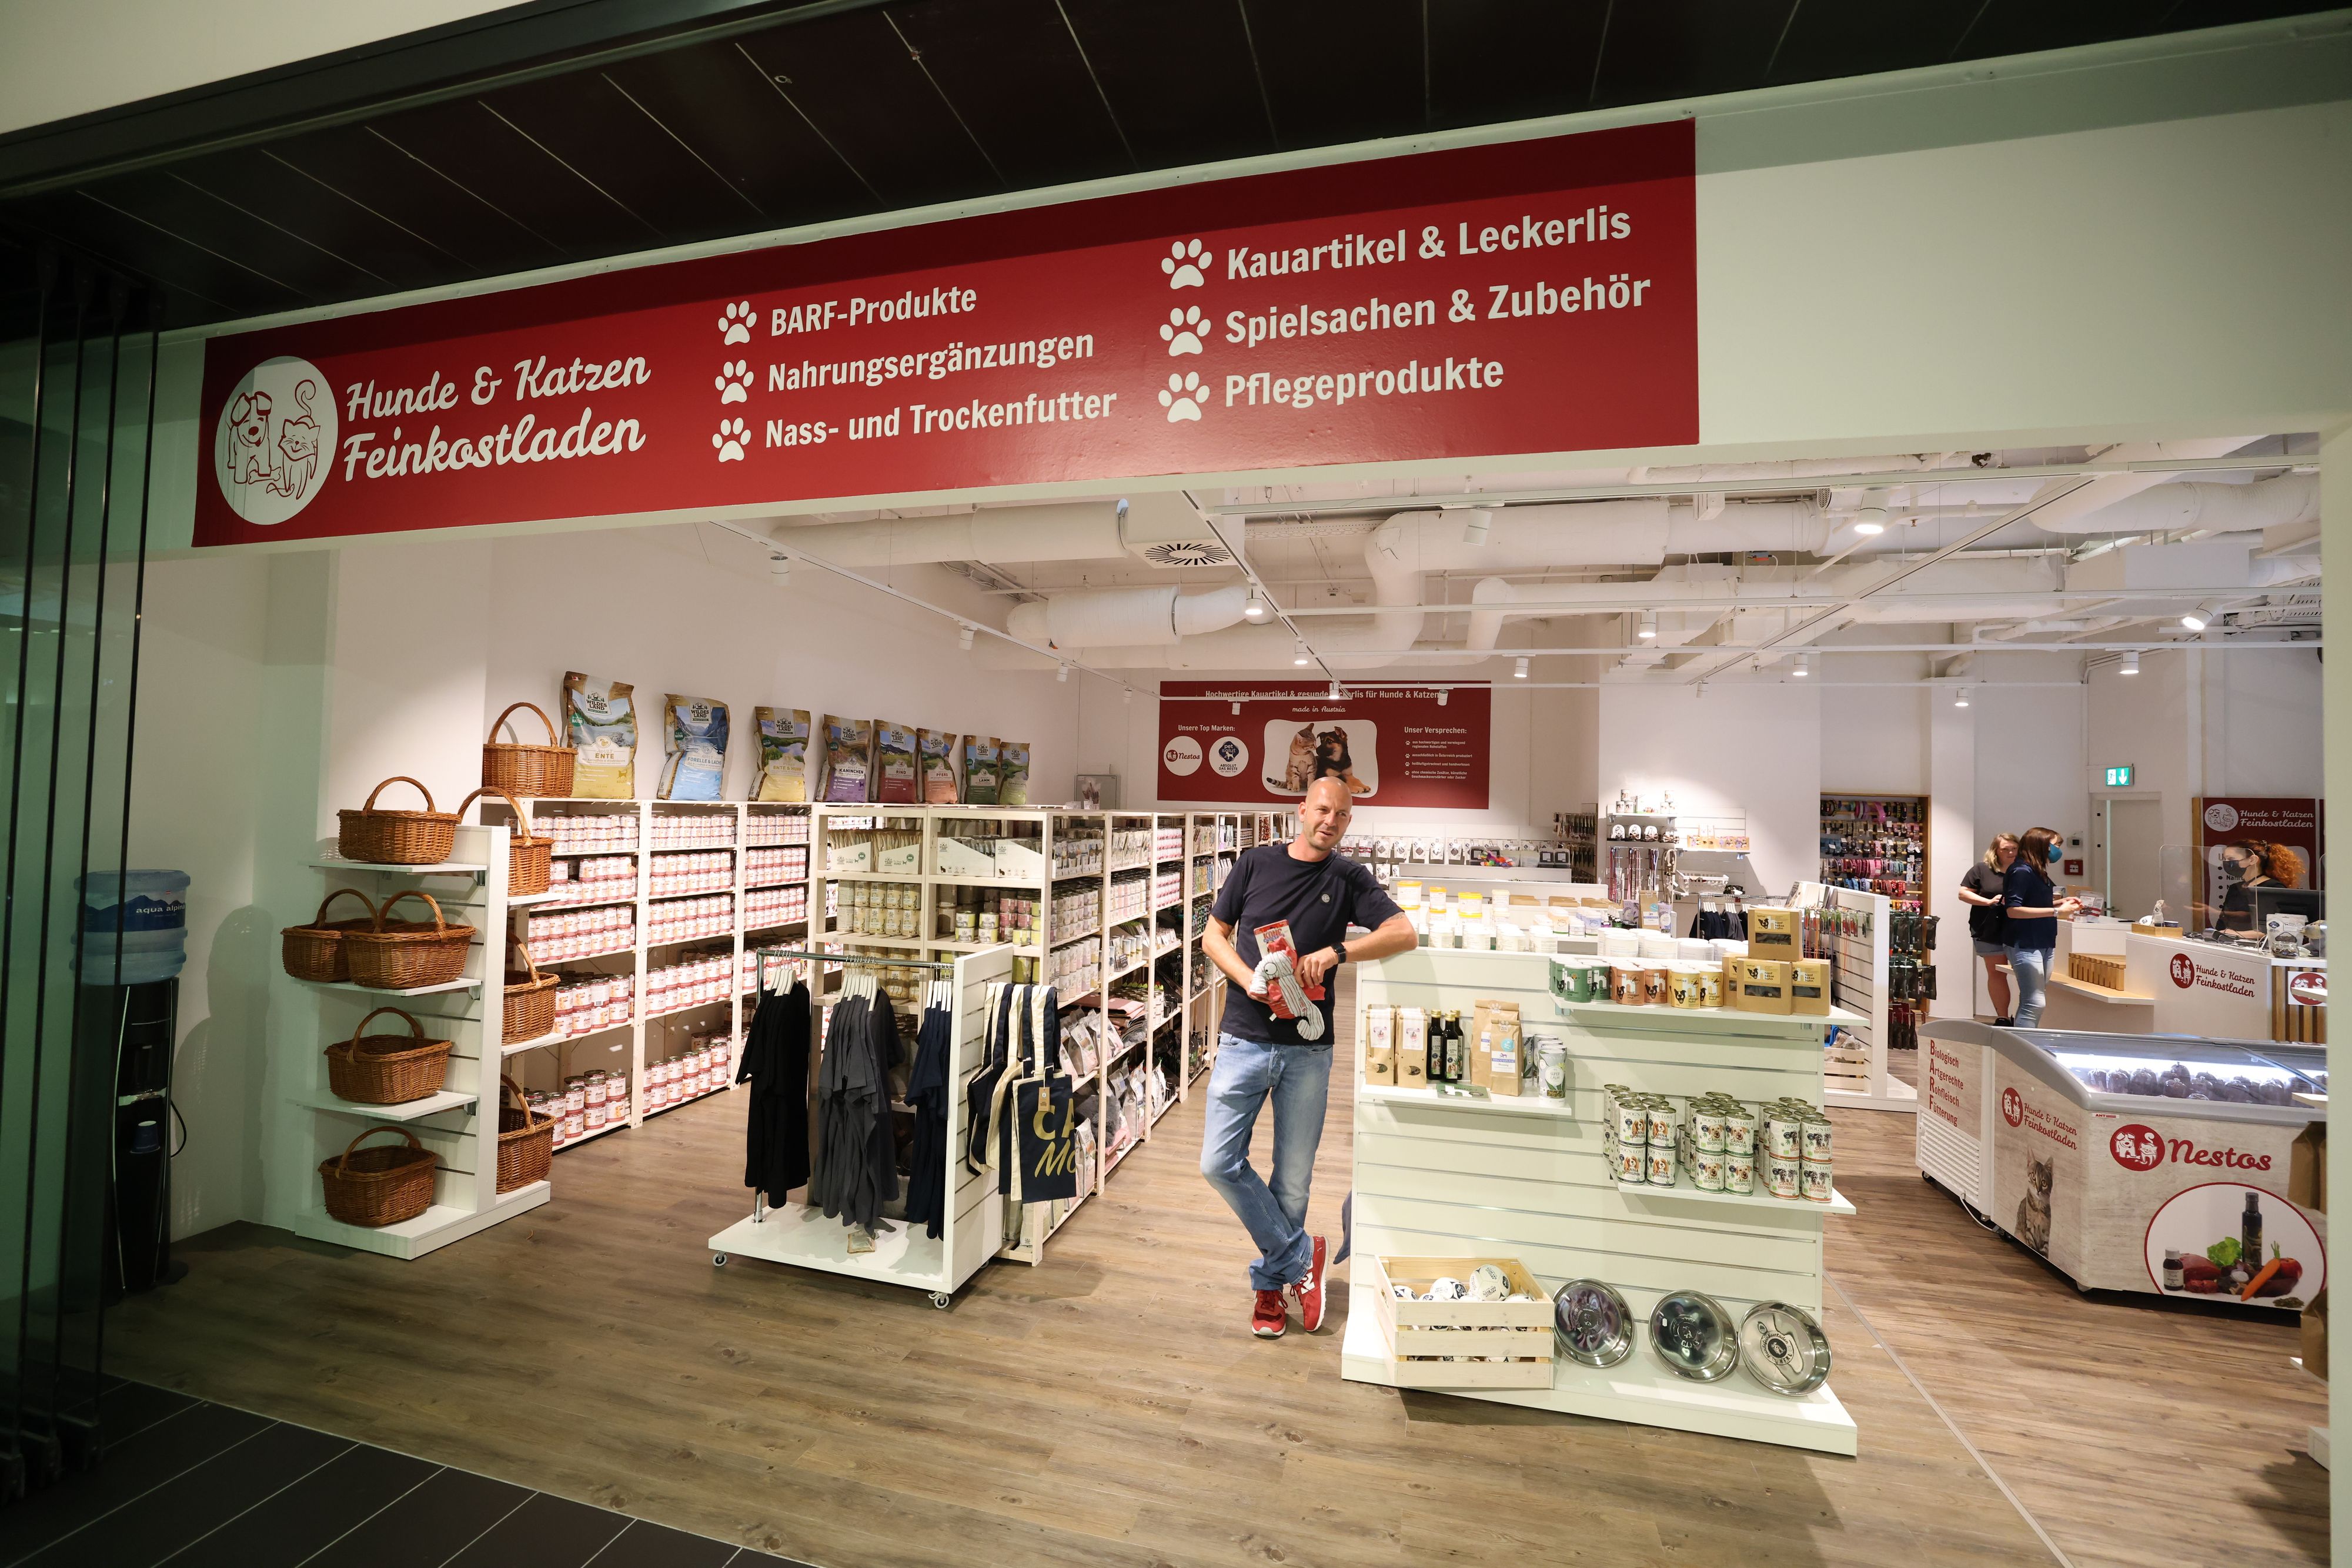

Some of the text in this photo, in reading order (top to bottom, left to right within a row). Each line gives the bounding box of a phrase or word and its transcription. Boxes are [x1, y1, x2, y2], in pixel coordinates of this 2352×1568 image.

[1228, 205, 1631, 280] Kauartikel & Leckerlis
[771, 286, 977, 336] BARF-Produkte
[1225, 273, 1651, 347] Spielsachen & Zubehör
[768, 333, 1094, 392] Nahrungsergänzungen
[347, 355, 651, 421] Hunde & Katzen
[1225, 357, 1504, 408] Pflegeprodukte
[766, 391, 1117, 449] Nass- und Trockenfutter
[343, 406, 647, 482] Feinkostladen
[586, 699, 607, 707] WILDES
[1414, 690, 1438, 698] Katzen
[2240, 818, 2314, 828] Feinkostladen
[1263, 928, 1282, 940] KONG
[2196, 964, 2255, 984] Hunde & Katzen
[2196, 975, 2255, 998] Feinkostladen
[1930, 1039, 1959, 1068] Biologisch
[1929, 1058, 1964, 1090] Artgerechte
[1929, 1076, 1959, 1107] Rohfleisch
[1929, 1094, 1958, 1128] Fütterung
[2024, 1103, 2077, 1136] Hunde & Katzen
[2023, 1115, 2077, 1151] Feinkostladen
[2167, 1138, 2272, 1172] Nestos
